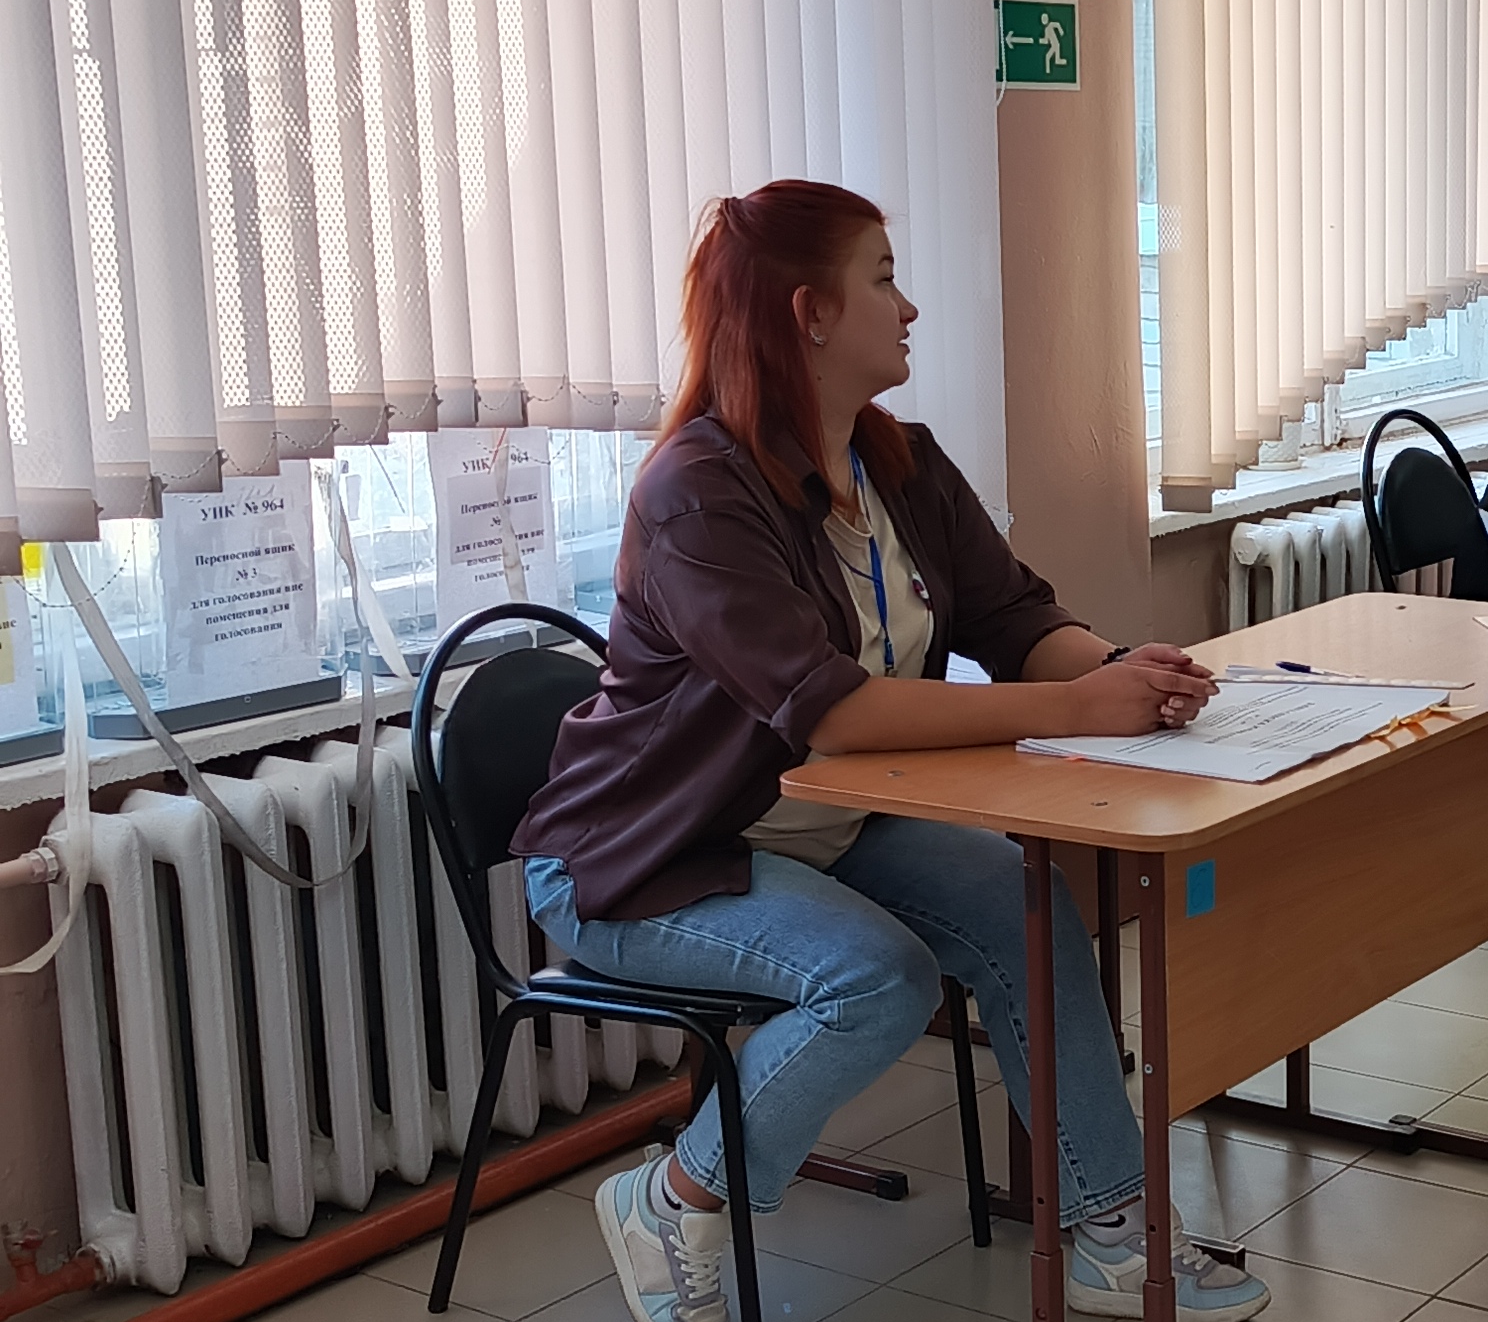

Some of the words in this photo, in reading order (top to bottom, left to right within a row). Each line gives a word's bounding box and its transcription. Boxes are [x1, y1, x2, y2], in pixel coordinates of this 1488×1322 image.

[462, 457, 490, 473] УИК
[510, 451, 529, 464] 964
[201, 504, 235, 521] УИК
[242, 501, 259, 515] №
[261, 498, 285, 514] 964
[460, 496, 512, 515] Переносой
[195, 547, 261, 567] Переносной
[264, 543, 296, 557] ящик
[235, 568, 249, 582] №
[251, 567, 258, 579] 3
[190, 599, 210, 611] для
[212, 586, 281, 607] голосования
[284, 582, 304, 593] вне
[0, 619, 17, 630] не
[205, 607, 268, 625] помещения
[270, 602, 290, 615] для
